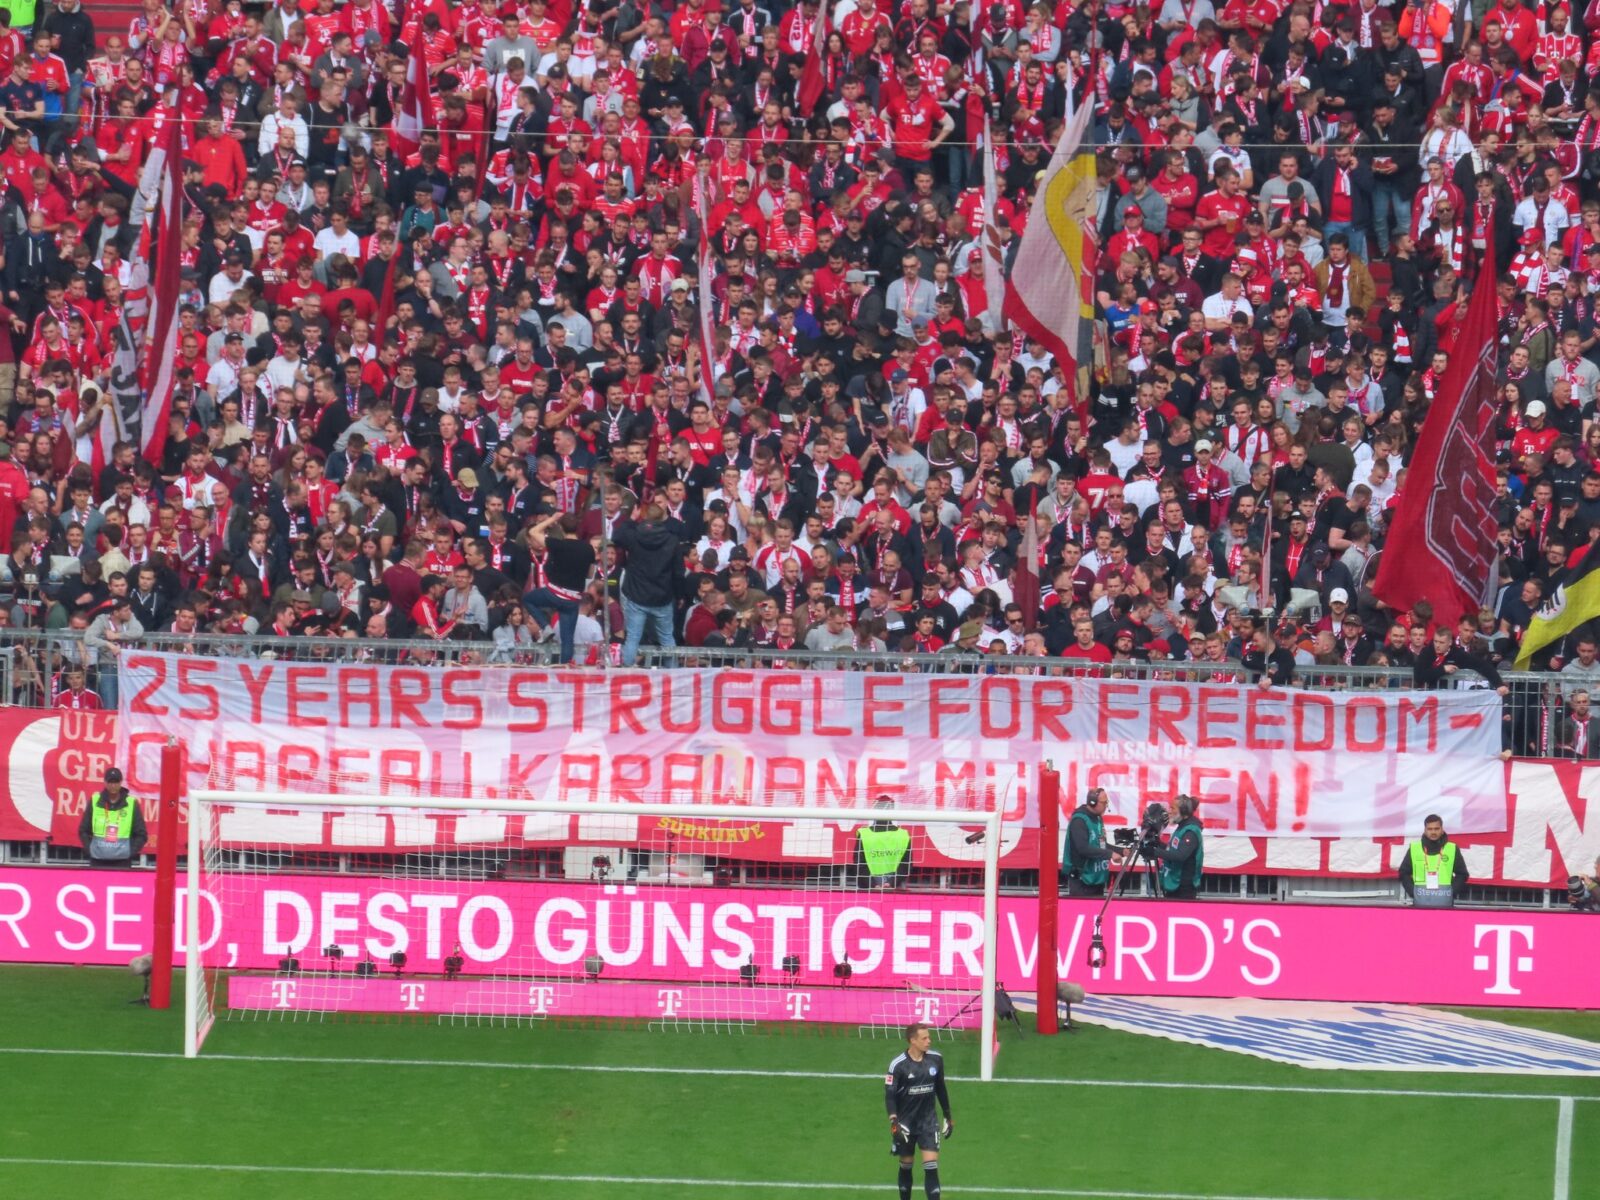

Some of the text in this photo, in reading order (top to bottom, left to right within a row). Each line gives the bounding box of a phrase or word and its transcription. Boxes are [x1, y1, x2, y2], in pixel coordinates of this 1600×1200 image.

[127, 655, 219, 721] 25
[238, 663, 483, 730] YEARS
[507, 672, 904, 737] STRUGGLE
[929, 677, 1073, 741] FOR
[508, 750, 907, 815] KARAWANE
[55, 884, 239, 967] SED,
[263, 889, 514, 963] DESTO
[534, 885, 985, 977] GÜNSTIGER
